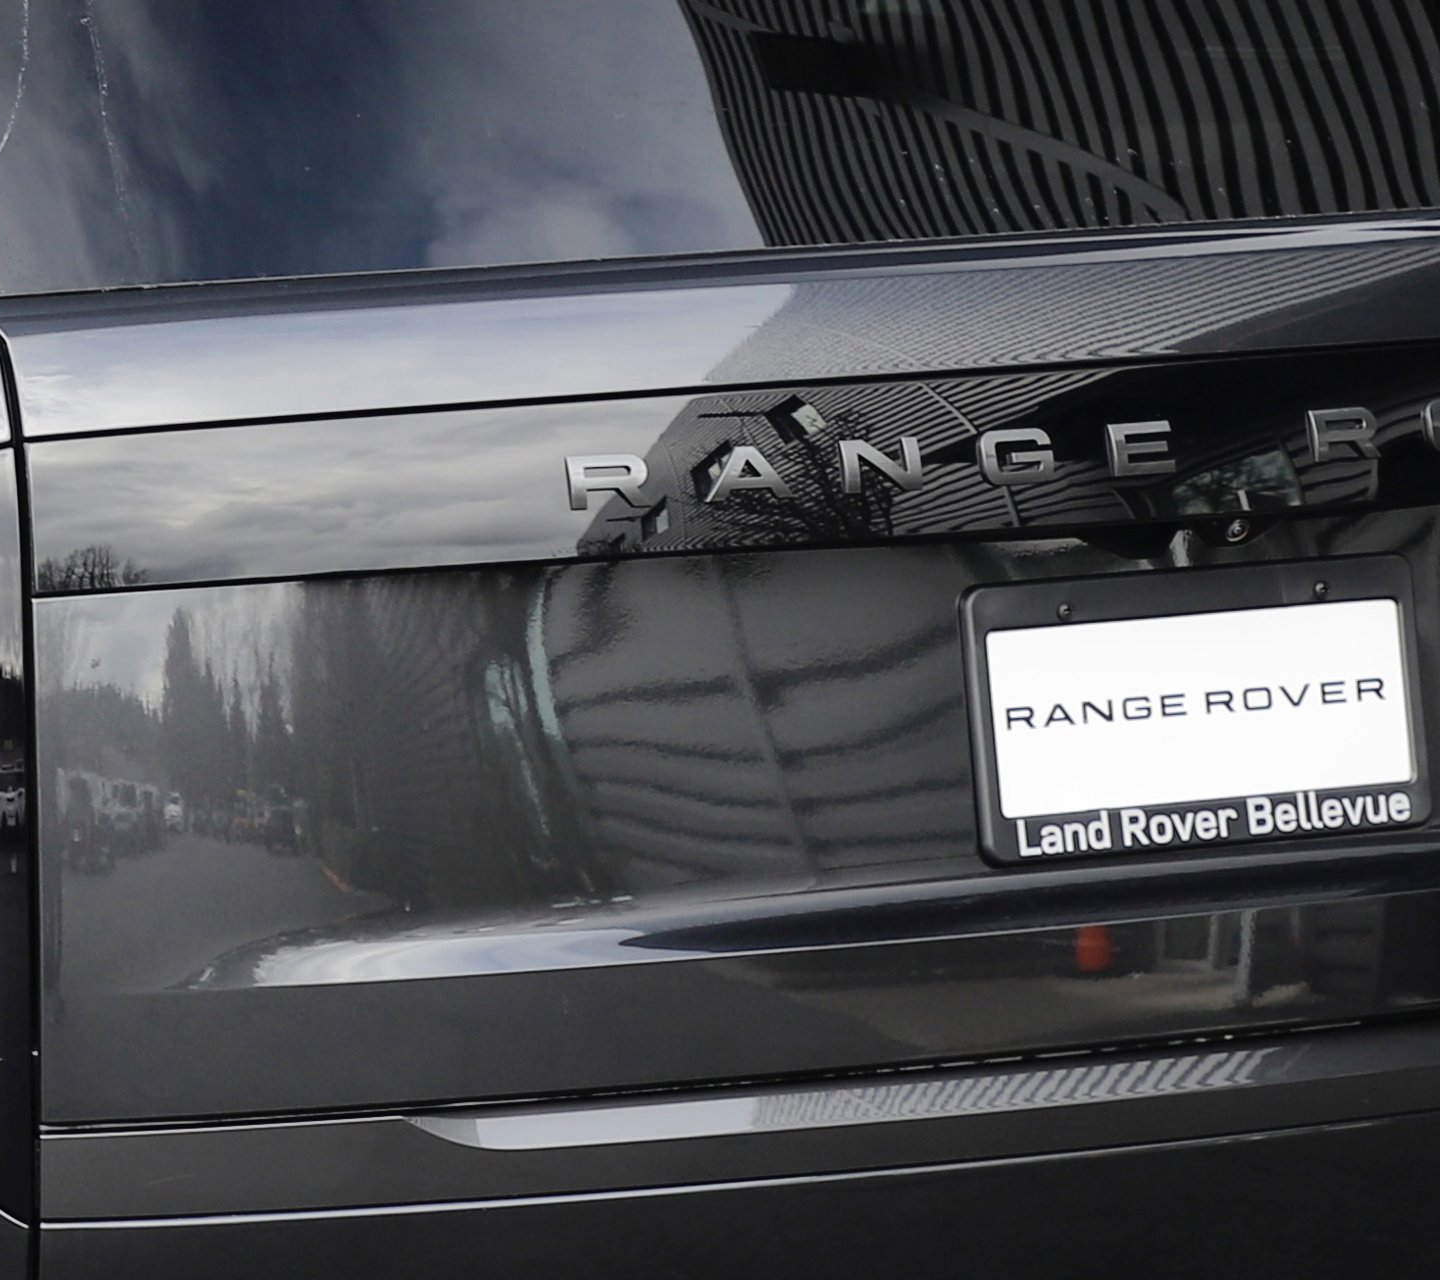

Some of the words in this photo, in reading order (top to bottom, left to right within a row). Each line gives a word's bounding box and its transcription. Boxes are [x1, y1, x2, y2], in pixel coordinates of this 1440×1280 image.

[566, 418, 1177, 513] RANGE
[1005, 693, 1188, 731] RANGE
[1205, 677, 1386, 715] ROVER
[1015, 809, 1113, 858] Land
[1120, 806, 1239, 848] Rover
[1245, 790, 1412, 836] Bellevue
